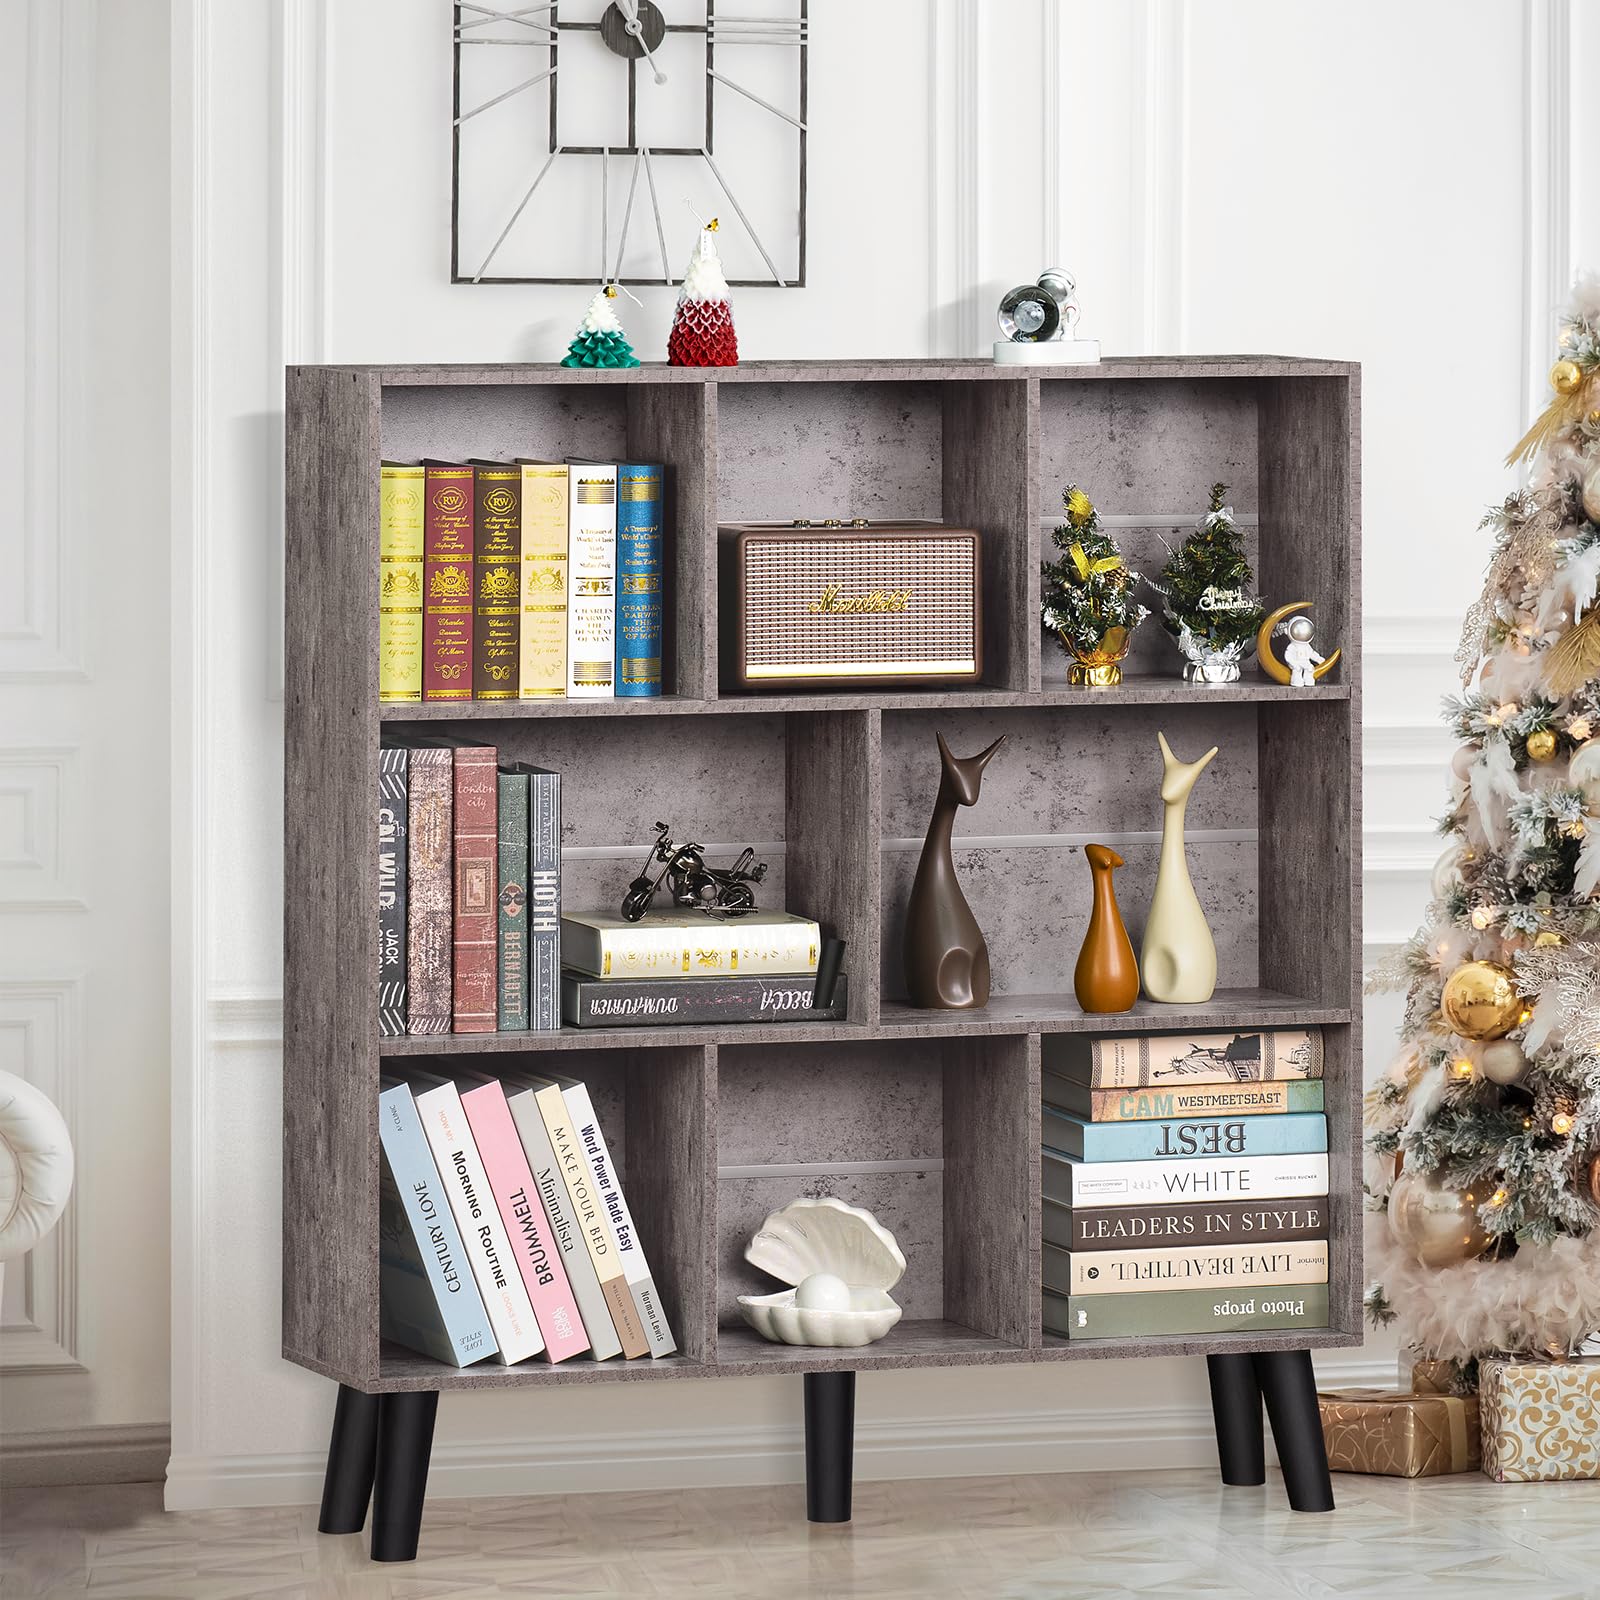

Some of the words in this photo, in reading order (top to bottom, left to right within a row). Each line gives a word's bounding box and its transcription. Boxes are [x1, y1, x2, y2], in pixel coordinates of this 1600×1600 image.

[443, 496, 459, 505] RW
[493, 497, 509, 506] RW
[1199, 596, 1254, 610] Christmas
[1201, 584, 1242, 600] Merry
[533, 871, 557, 931] HOTH
[385, 928, 398, 965] JACK
[590, 997, 679, 1015] DUMAURIER
[1119, 1094, 1174, 1118] CAM
[1178, 1092, 1282, 1108] WESTMEETSEAST
[1154, 1121, 1247, 1156] BEST
[553, 1127, 579, 1174] MAKE
[573, 1177, 595, 1223] YOUR
[589, 1226, 607, 1256] BED
[581, 1124, 601, 1155] Word
[591, 1155, 612, 1190] Power
[604, 1191, 624, 1224] Made
[616, 1224, 634, 1253] Easy
[1163, 1170, 1250, 1193] WHITE
[413, 1180, 437, 1221] LOVE
[537, 1167, 574, 1253] Minimalista
[451, 1150, 482, 1219] MORNING
[478, 1225, 507, 1289] ROUTINE
[1080, 1215, 1195, 1239] LEADERS
[1205, 1213, 1232, 1233] IN
[1241, 1209, 1321, 1230] STYLE
[509, 1187, 555, 1286] BRUMMELL
[428, 1225, 461, 1293] CENTURY
[1111, 1256, 1234, 1280] BEAUTIFUL
[1242, 1254, 1292, 1274] LIVE
[1297, 1256, 1325, 1266] Interior
[641, 1290, 656, 1320] Norman
[651, 1319, 664, 1342] Lewis
[1214, 1300, 1256, 1316] props
[1261, 1300, 1305, 1315] Photo
